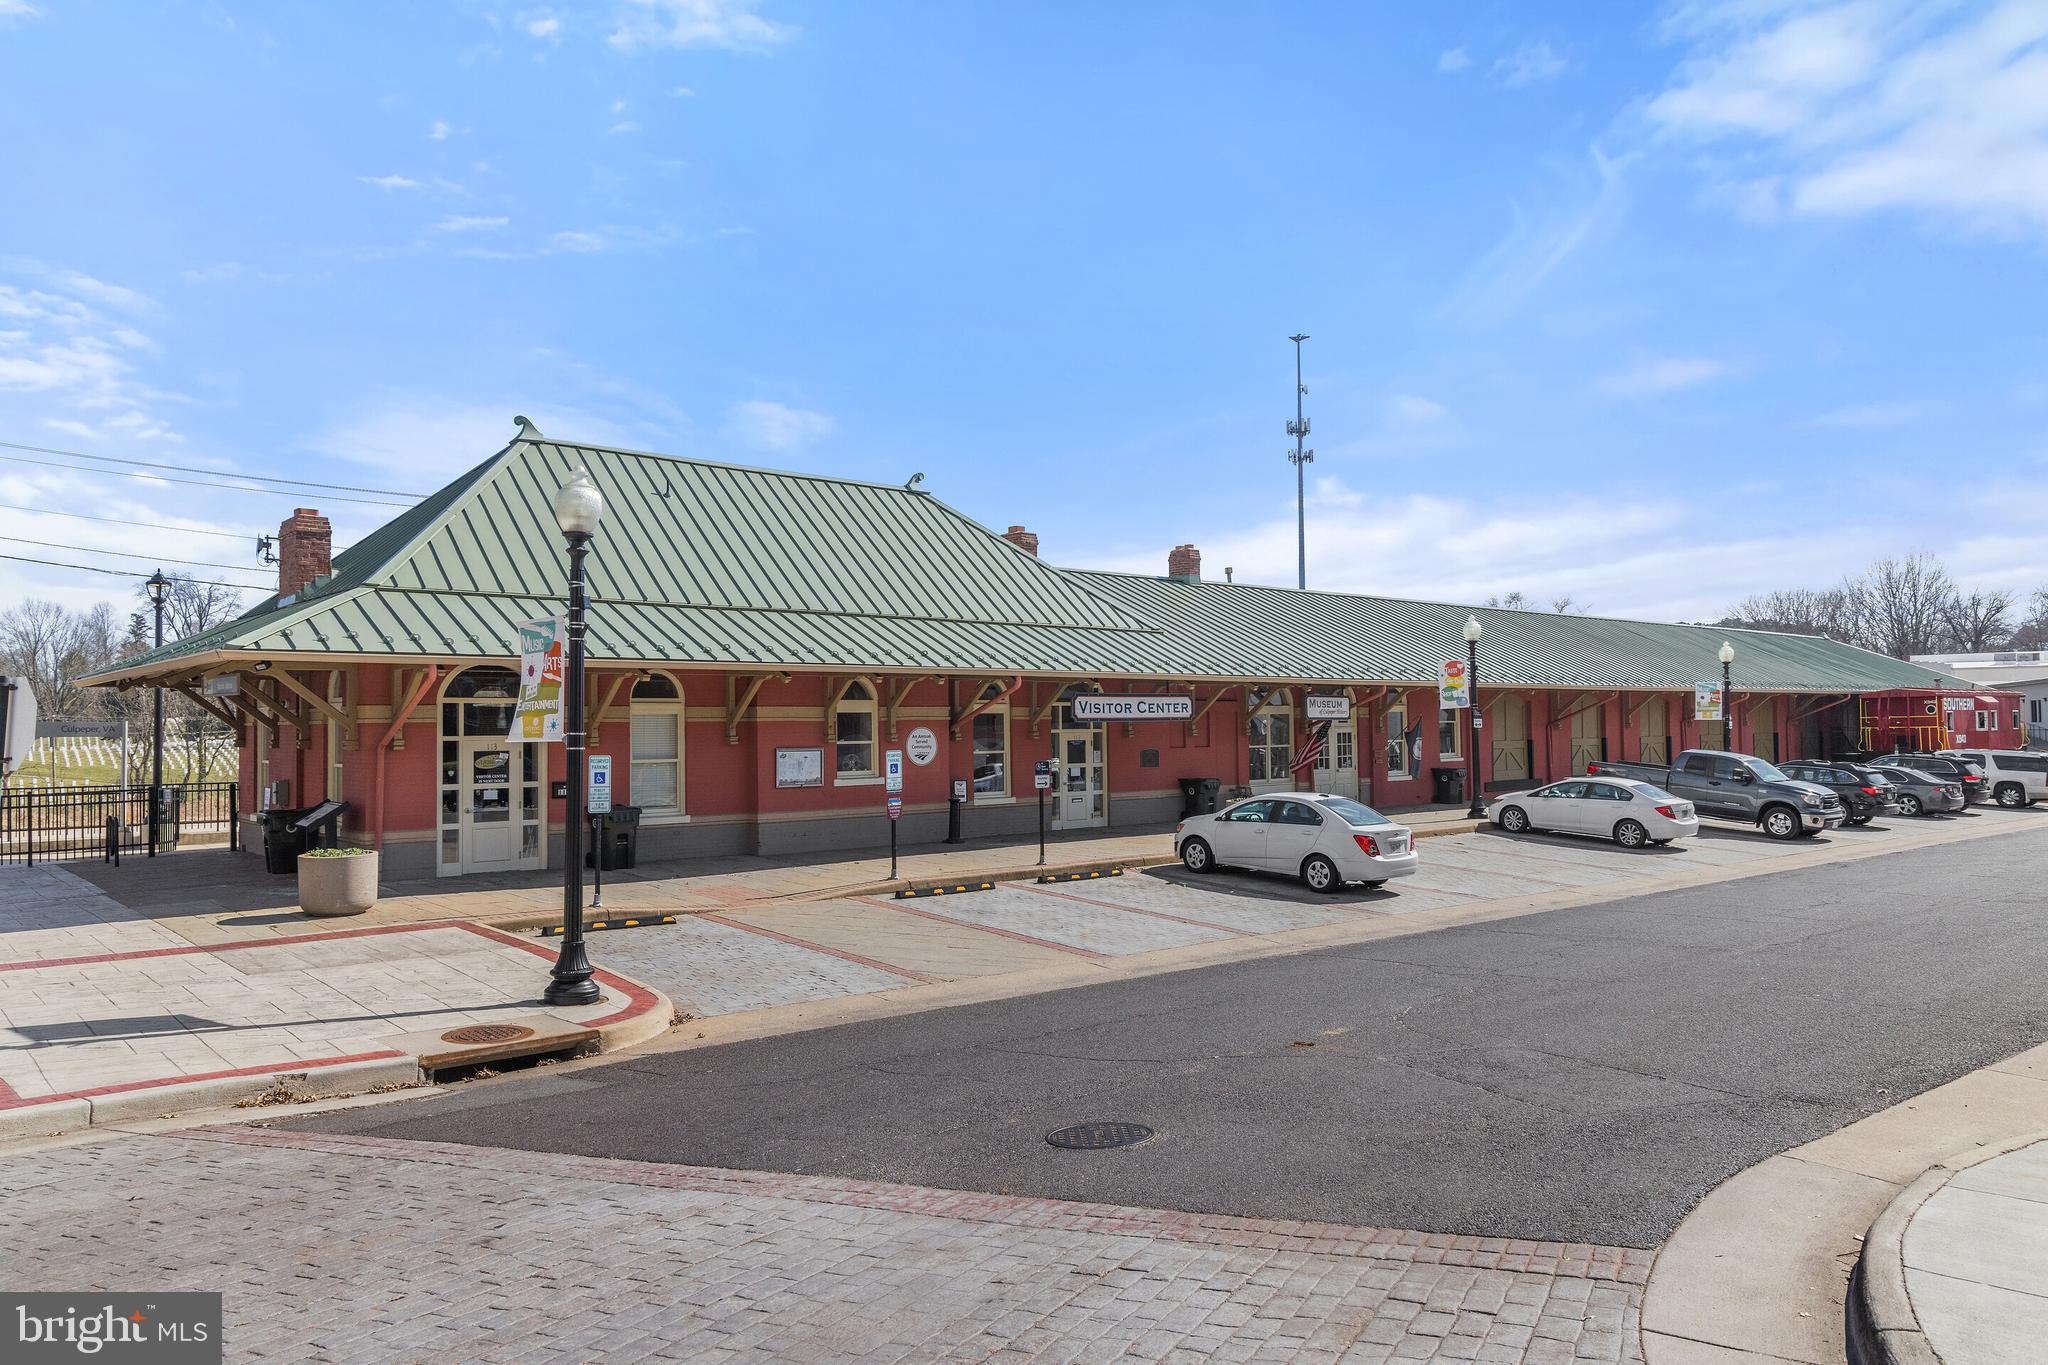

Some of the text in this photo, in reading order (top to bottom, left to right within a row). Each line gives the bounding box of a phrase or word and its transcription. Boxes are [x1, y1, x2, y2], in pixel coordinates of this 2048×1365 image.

[1078, 701, 1189, 714] VISITOR CENTER
[1308, 699, 1343, 709] MUSEUM
[1943, 697, 1974, 710] SOUTHERN
[61, 725, 115, 734] Culpeper, VA
